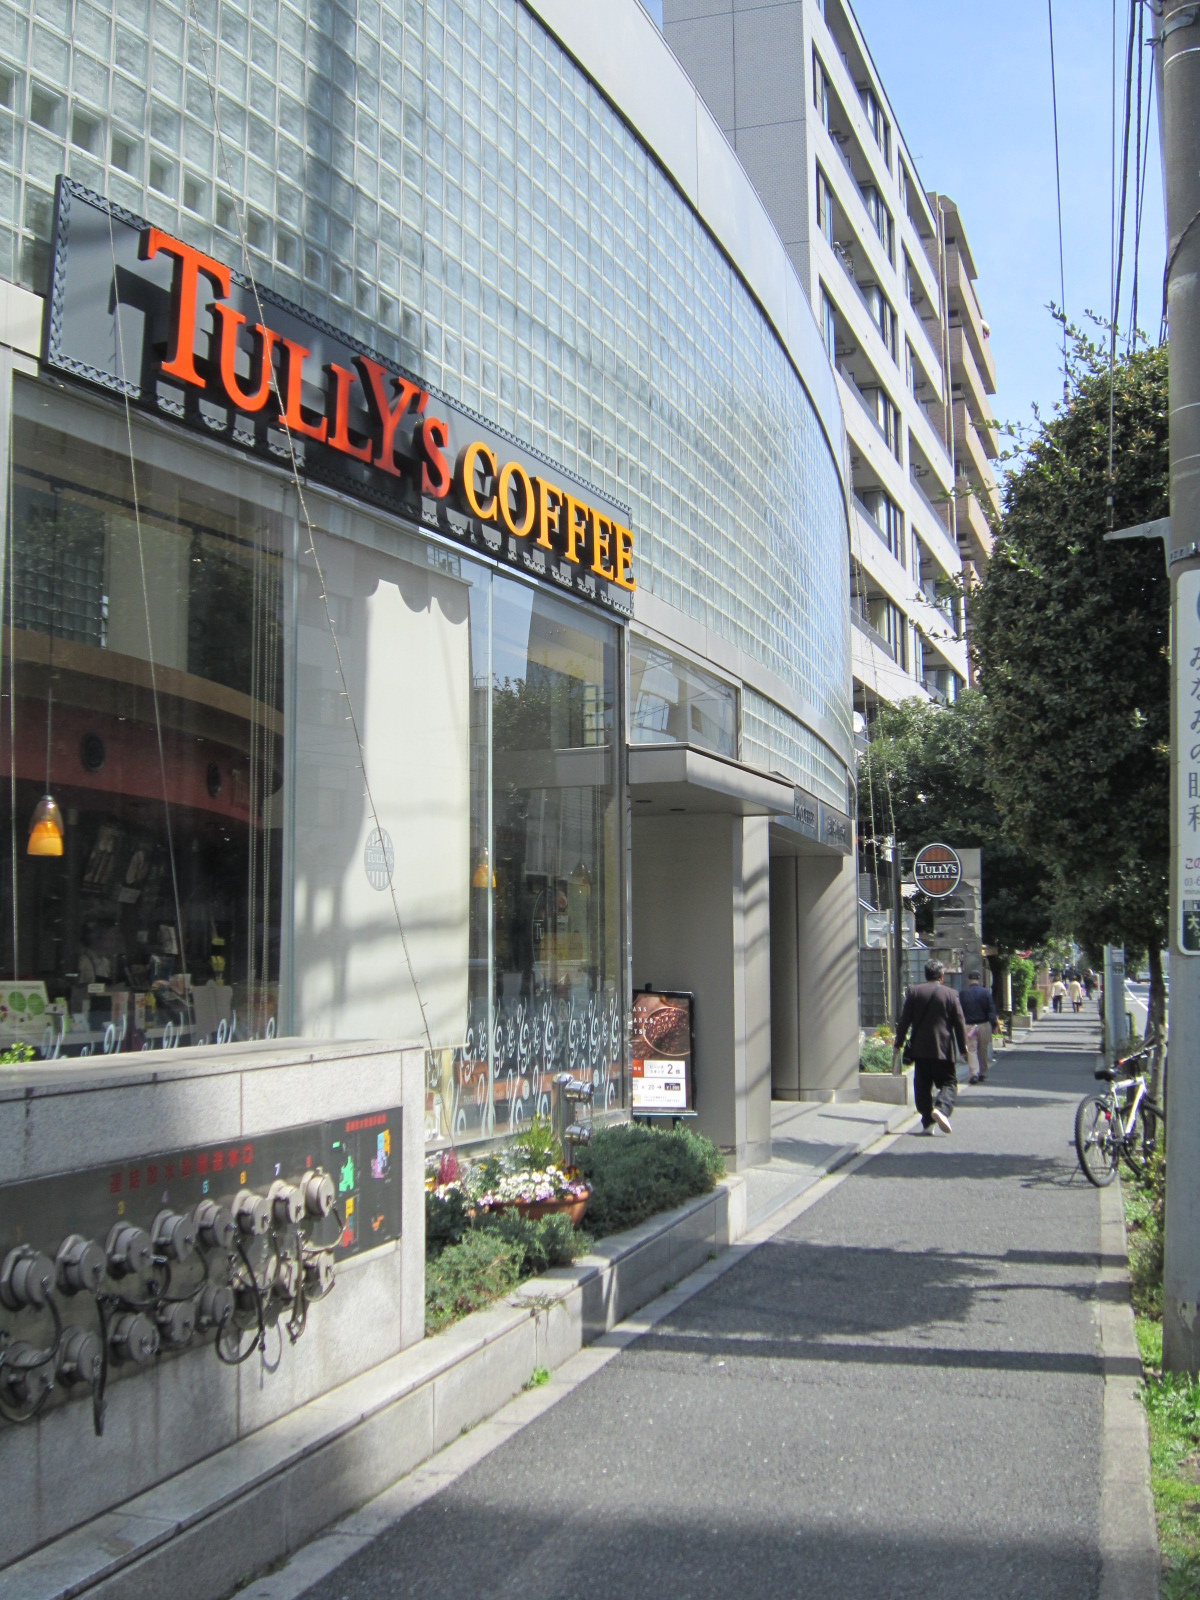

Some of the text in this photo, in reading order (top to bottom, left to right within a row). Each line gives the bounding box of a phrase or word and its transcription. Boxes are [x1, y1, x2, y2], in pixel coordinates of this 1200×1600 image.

[139, 227, 636, 591] TULLY'S COFFEE
[917, 863, 957, 874] TULLY'S
[667, 1063, 673, 1074] 2
[274, 1162, 281, 1176] 7
[202, 1180, 209, 1194] 5
[117, 1201, 125, 1215] 3
